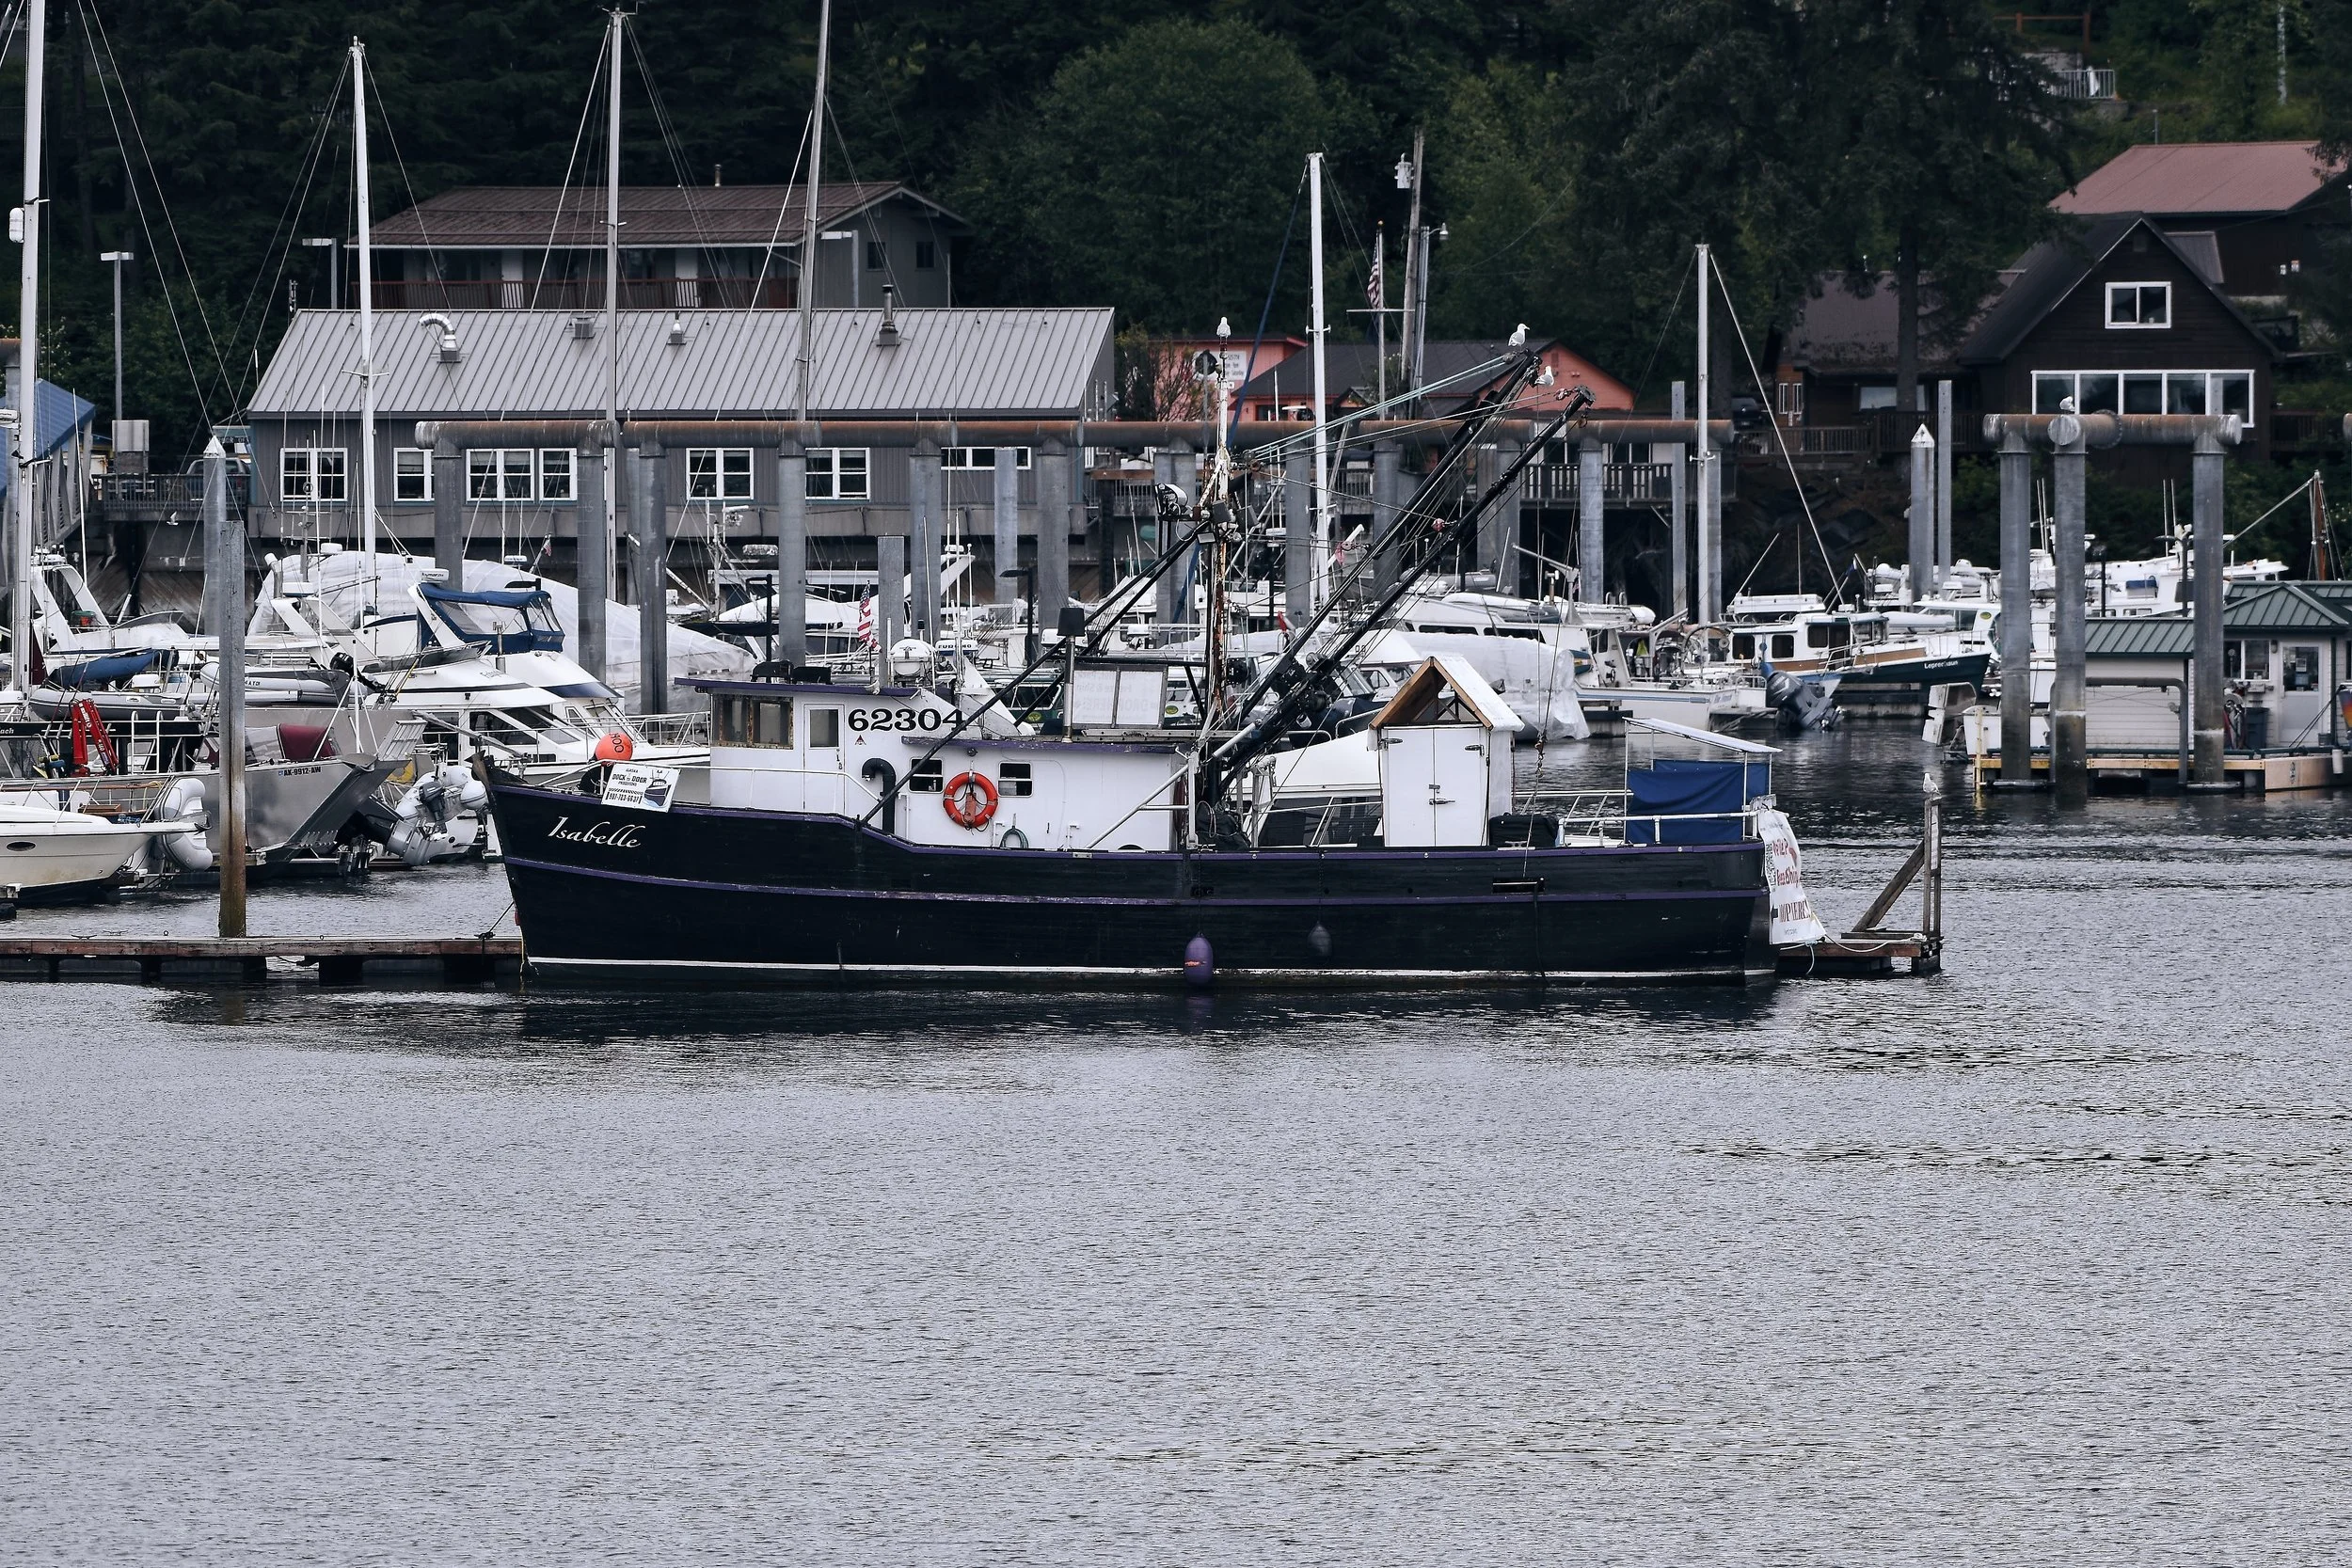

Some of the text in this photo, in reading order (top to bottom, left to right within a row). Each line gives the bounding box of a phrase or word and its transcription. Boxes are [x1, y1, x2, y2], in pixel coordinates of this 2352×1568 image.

[848, 708, 966, 732] 62304
[631, 775, 647, 784] DOOR
[548, 816, 646, 848] Isabelle
